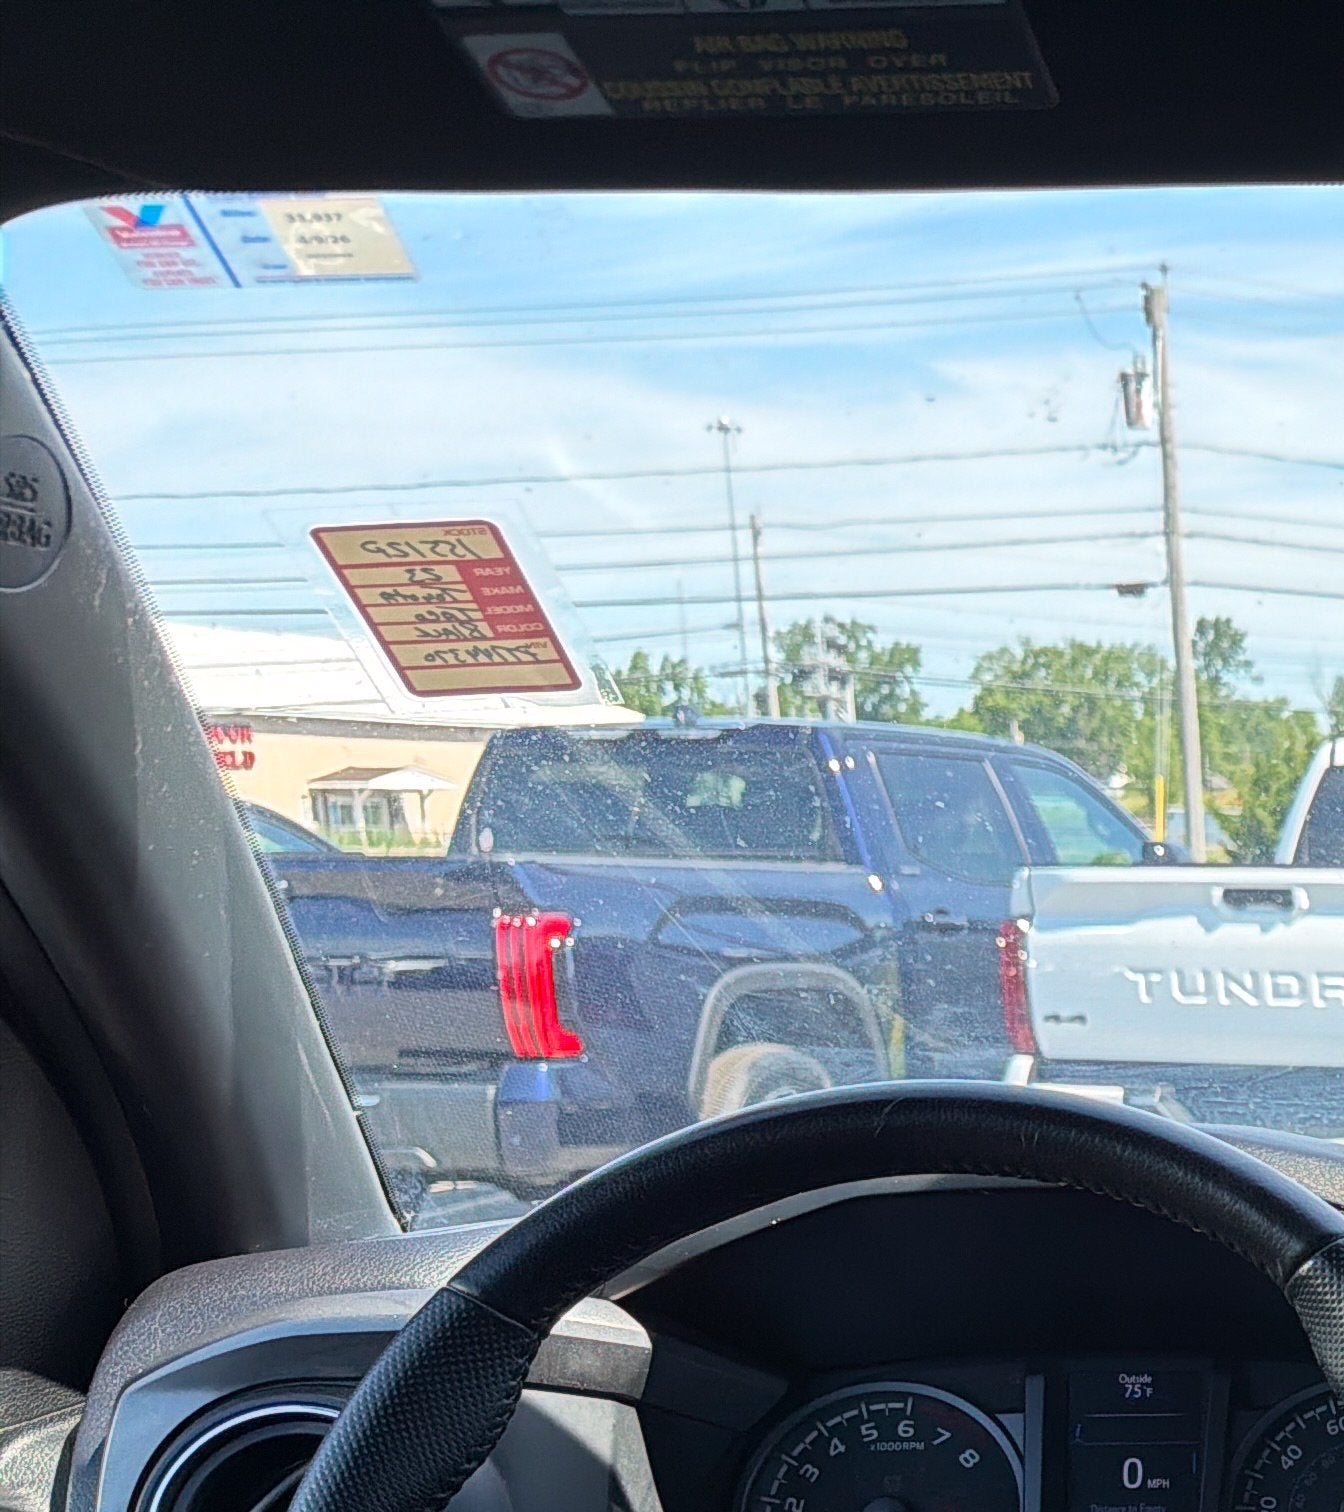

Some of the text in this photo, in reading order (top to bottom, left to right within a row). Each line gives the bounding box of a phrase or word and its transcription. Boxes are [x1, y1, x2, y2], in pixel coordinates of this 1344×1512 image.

[1118, 1373, 1153, 1385] Outside
[860, 1422, 878, 1442] 5
[897, 1420, 915, 1438] 6
[932, 1427, 952, 1446] 7
[829, 1436, 846, 1456] 4
[958, 1448, 981, 1469] 8
[1280, 1444, 1303, 1471] 40
[799, 1463, 820, 1483] 3
[1122, 1457, 1170, 1489] 0 MPH
